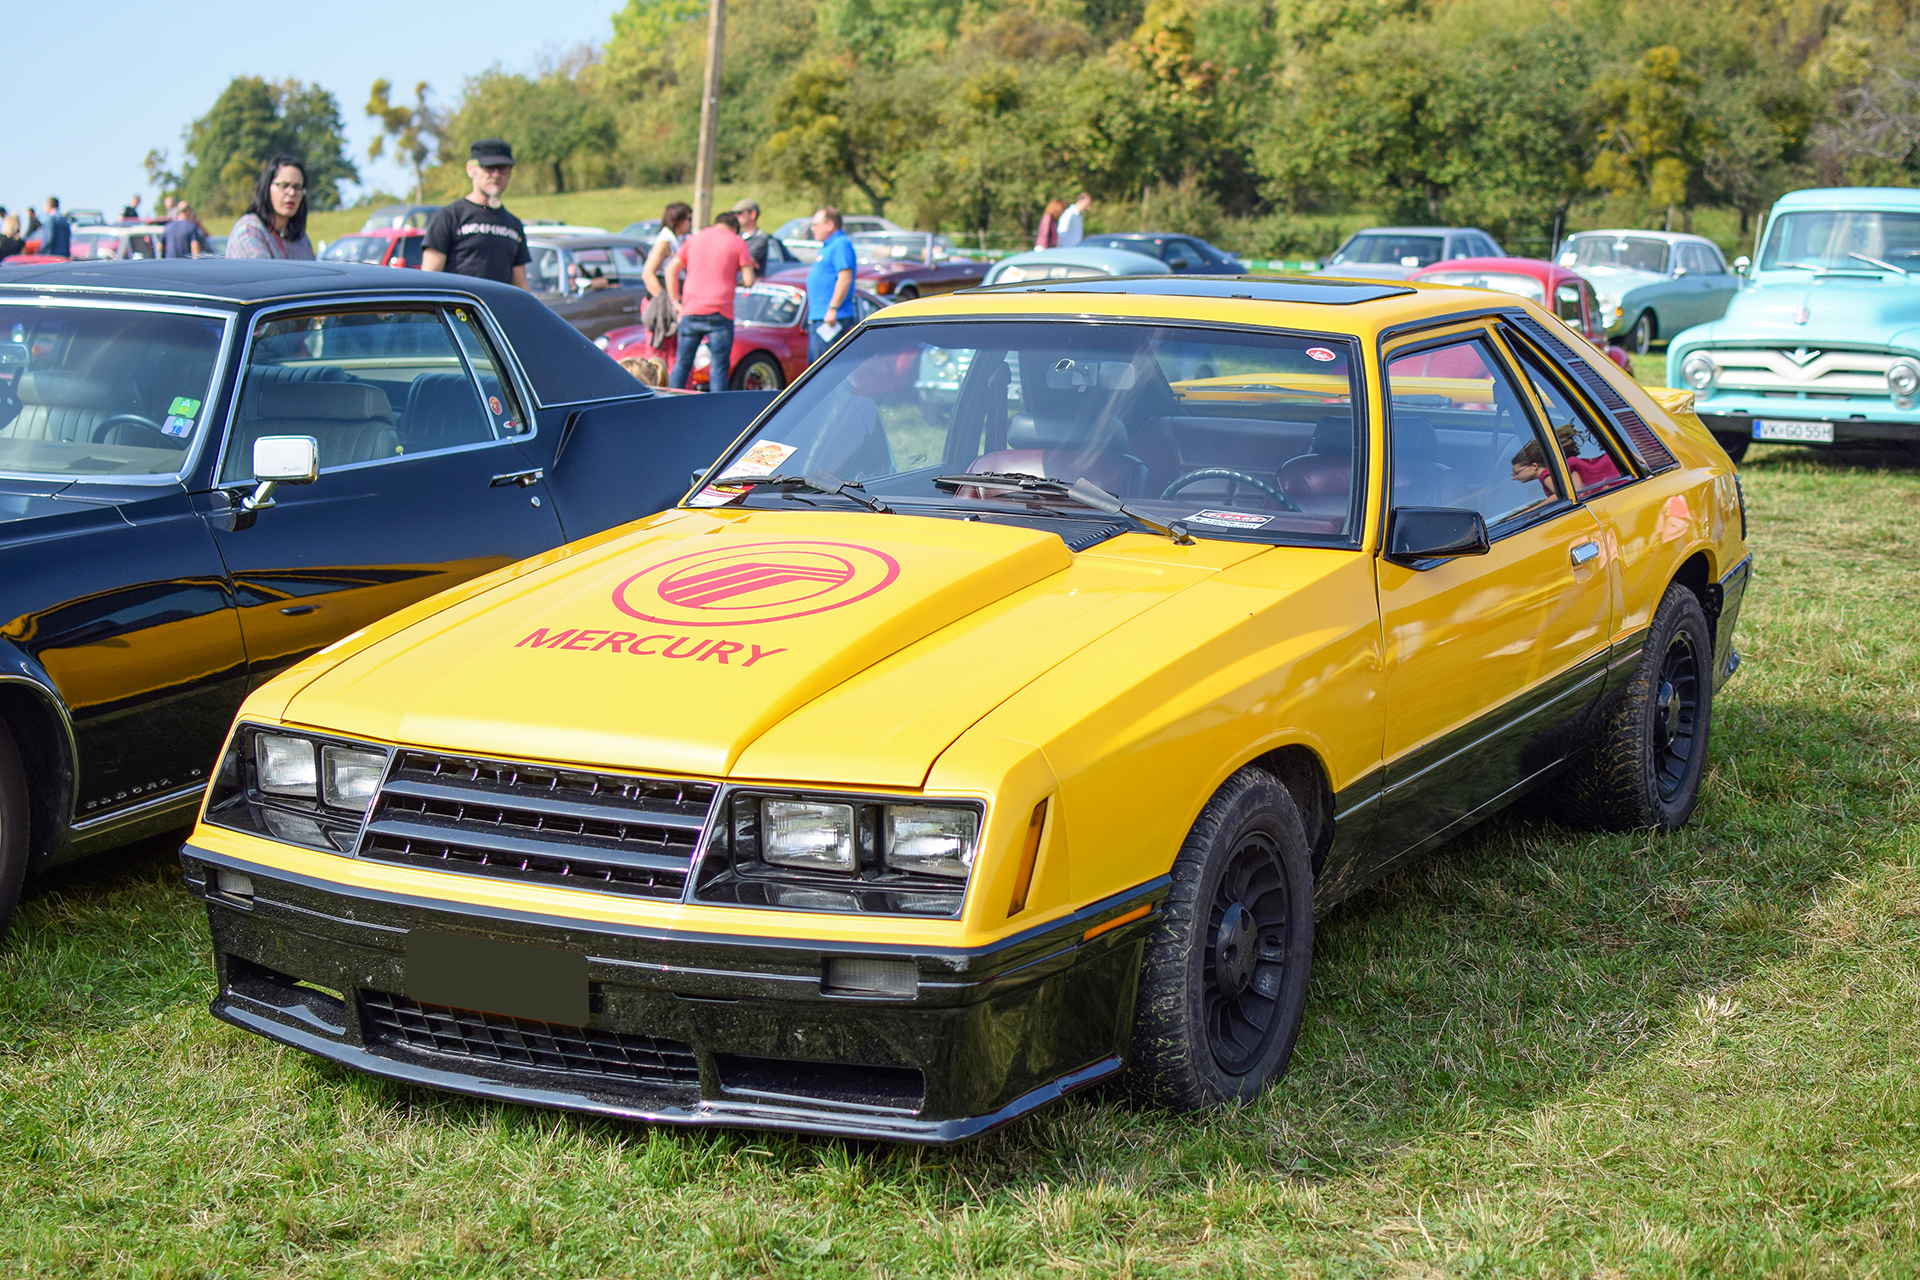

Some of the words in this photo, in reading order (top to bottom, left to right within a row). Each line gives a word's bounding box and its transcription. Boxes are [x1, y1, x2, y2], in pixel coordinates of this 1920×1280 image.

[172, 425, 183, 434] 16
[1761, 424, 1778, 436] VK
[1805, 426, 1831, 438] 55H
[513, 627, 789, 668] MERCURY
[85, 768, 201, 809] ELDORAO
